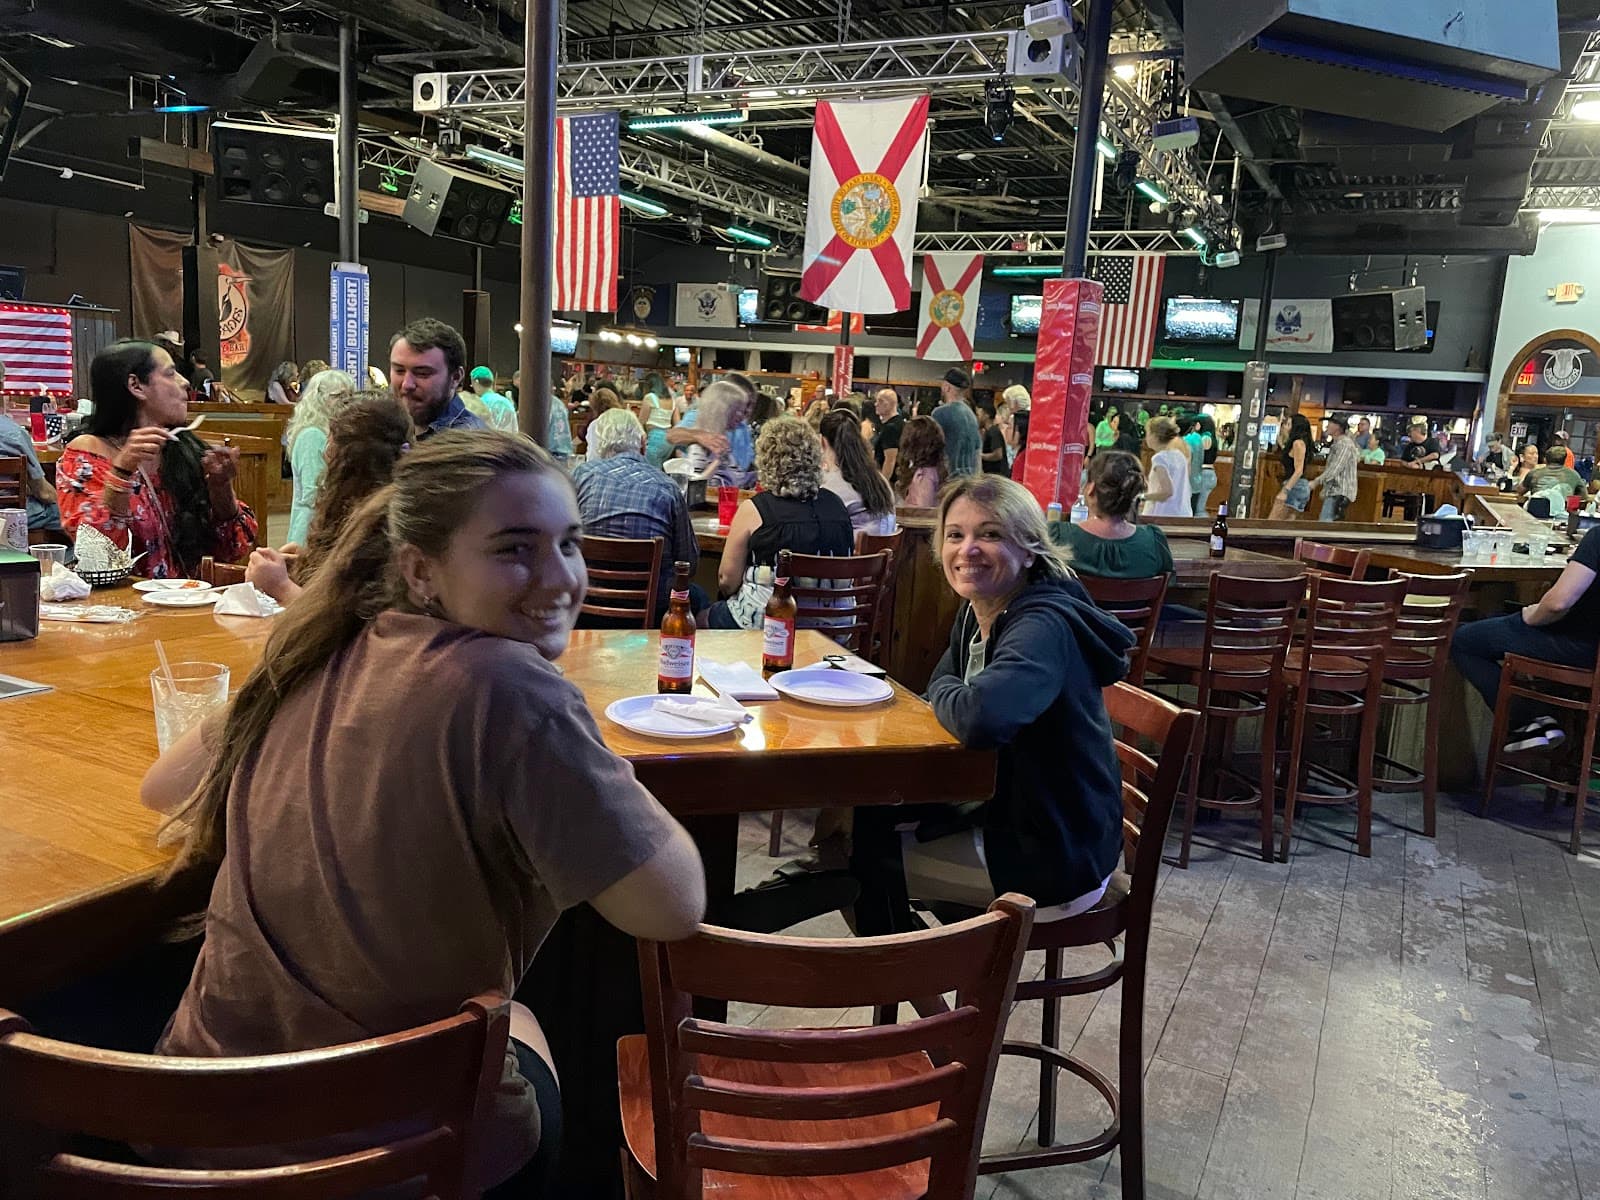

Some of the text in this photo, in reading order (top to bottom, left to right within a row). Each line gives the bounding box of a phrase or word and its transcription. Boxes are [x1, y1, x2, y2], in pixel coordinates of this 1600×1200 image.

[347, 280, 358, 347] BUD LIGHT
[1511, 426, 1526, 435] EXIT
